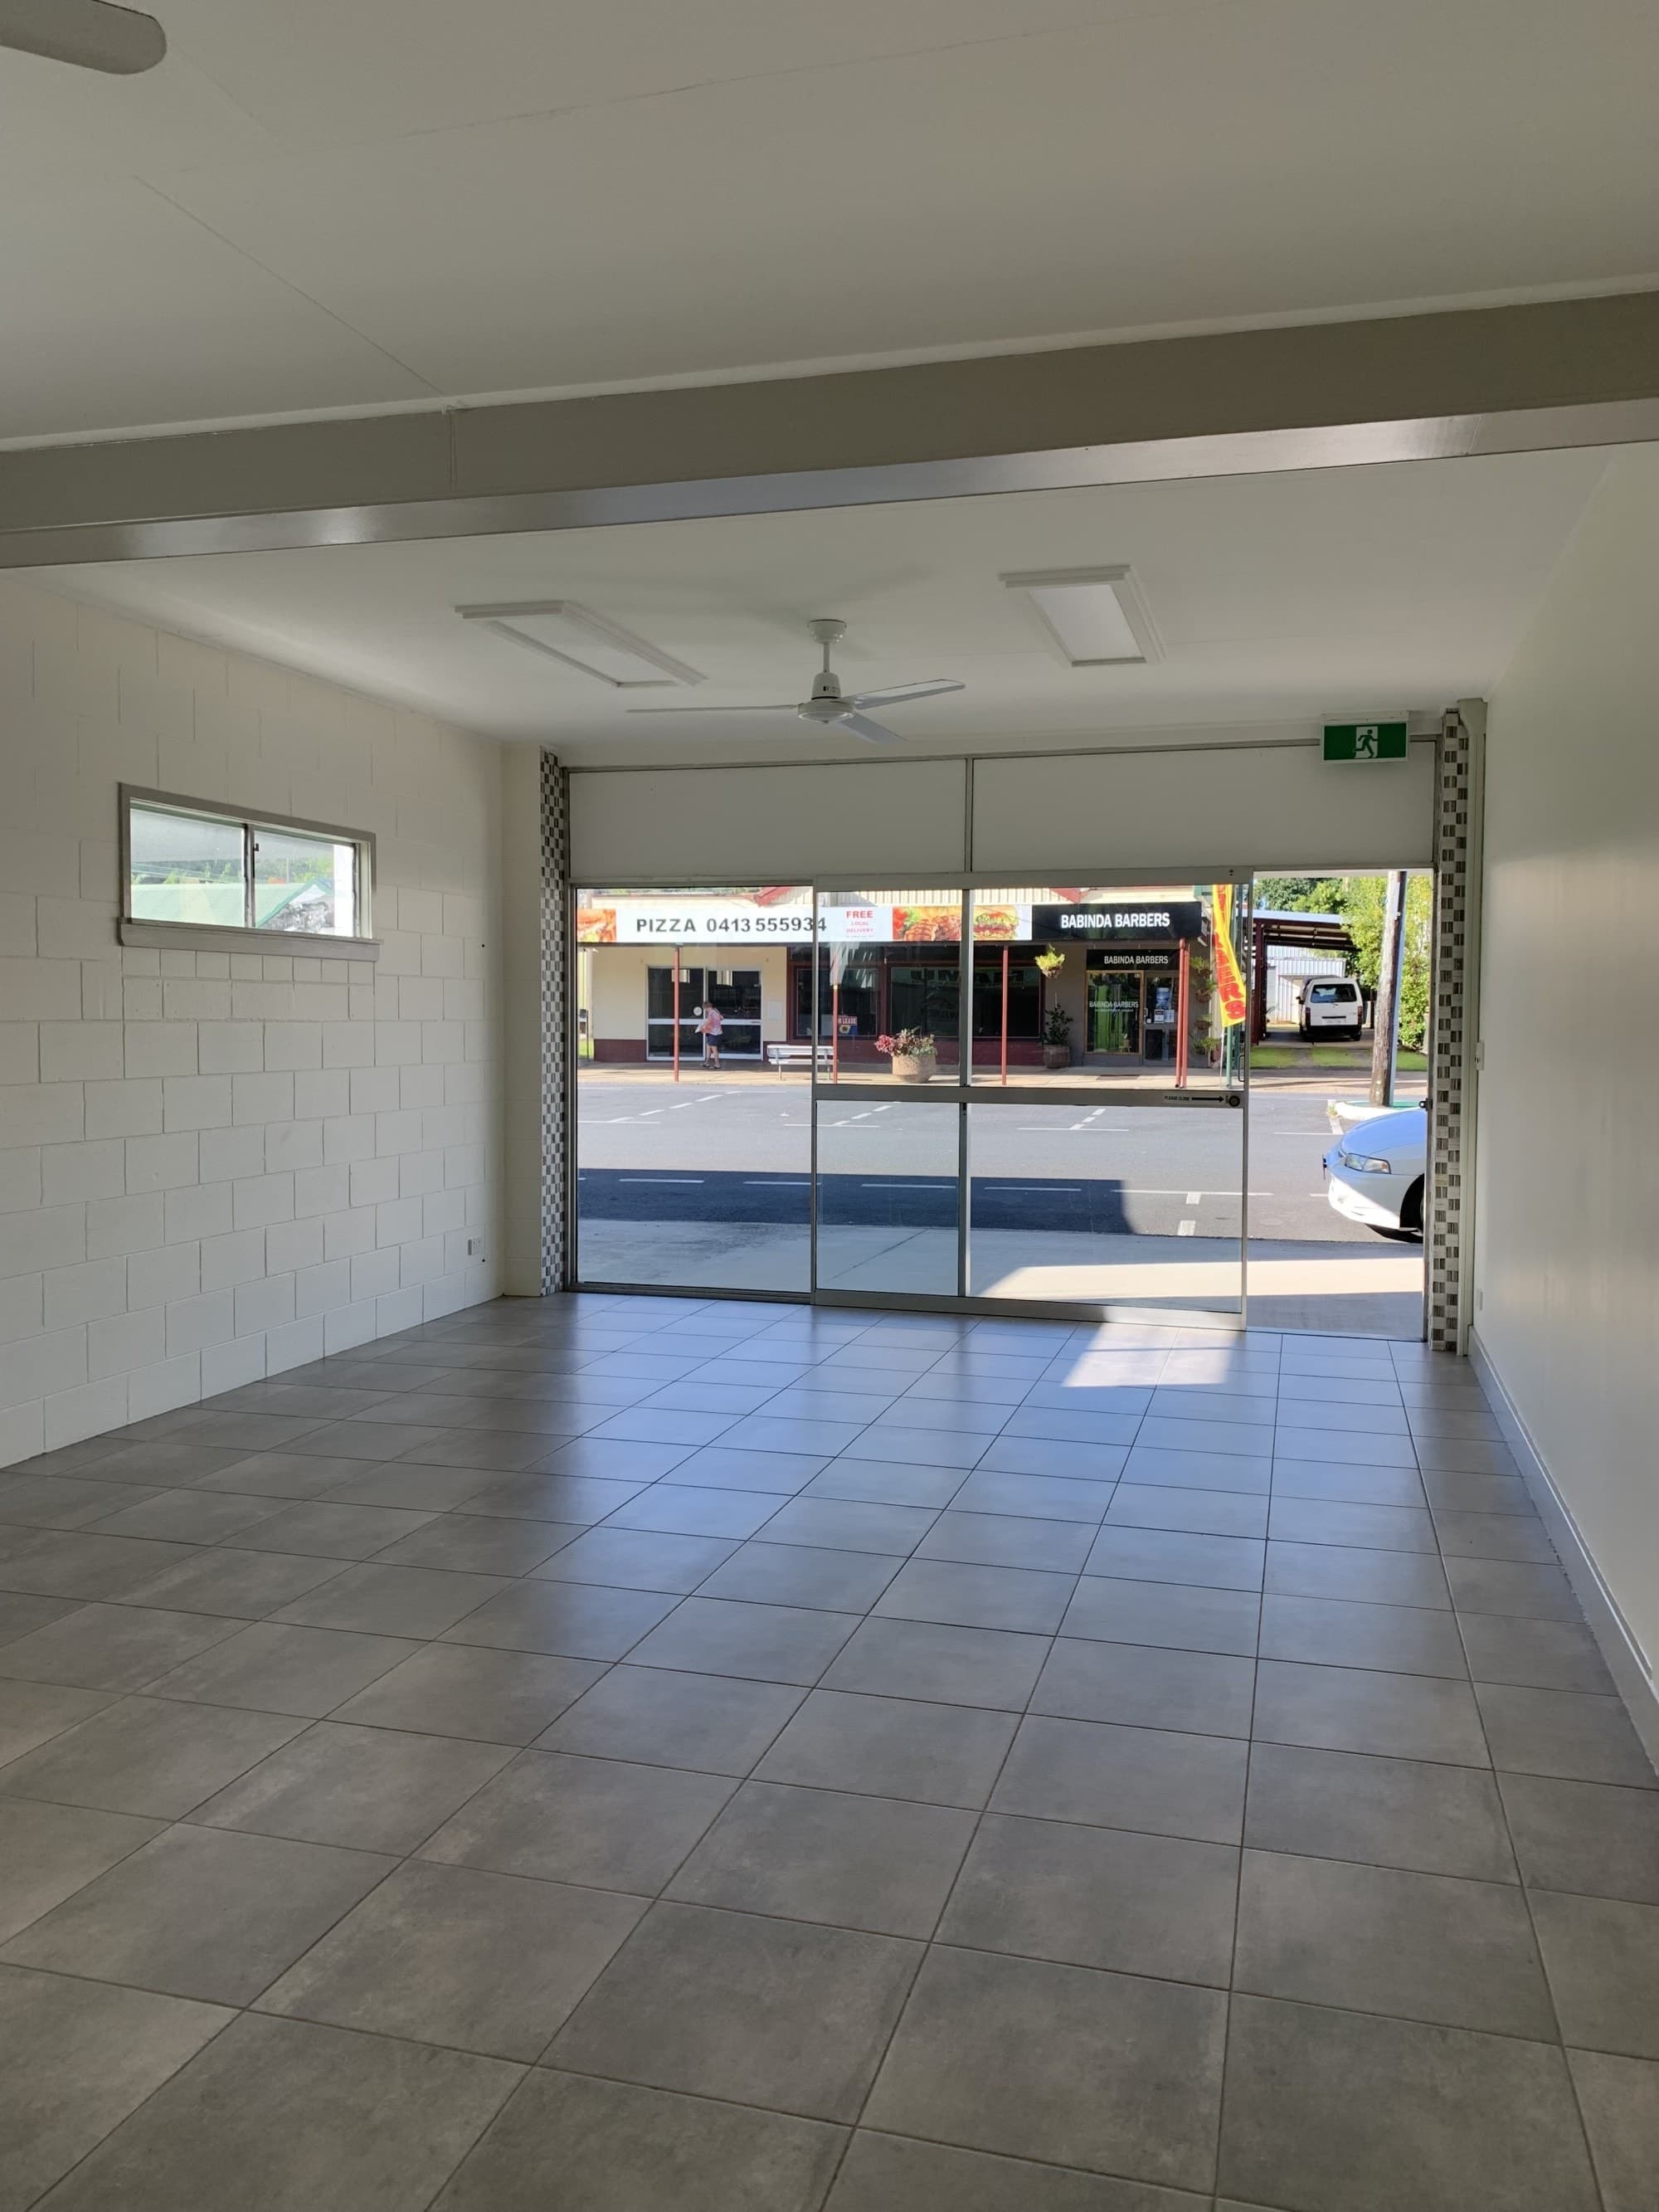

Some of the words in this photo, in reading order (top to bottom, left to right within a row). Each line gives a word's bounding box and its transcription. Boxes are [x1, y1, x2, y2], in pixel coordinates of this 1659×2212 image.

[846, 910, 873, 918] FREE
[636, 918, 696, 933] PIZZA
[706, 918, 751, 933] 0413
[756, 917, 827, 932] 555934
[1061, 914, 1112, 928] BABINDA
[1115, 913, 1170, 928] BARBERS
[1104, 956, 1134, 964] BABINDA
[1136, 956, 1169, 964] BARBERS
